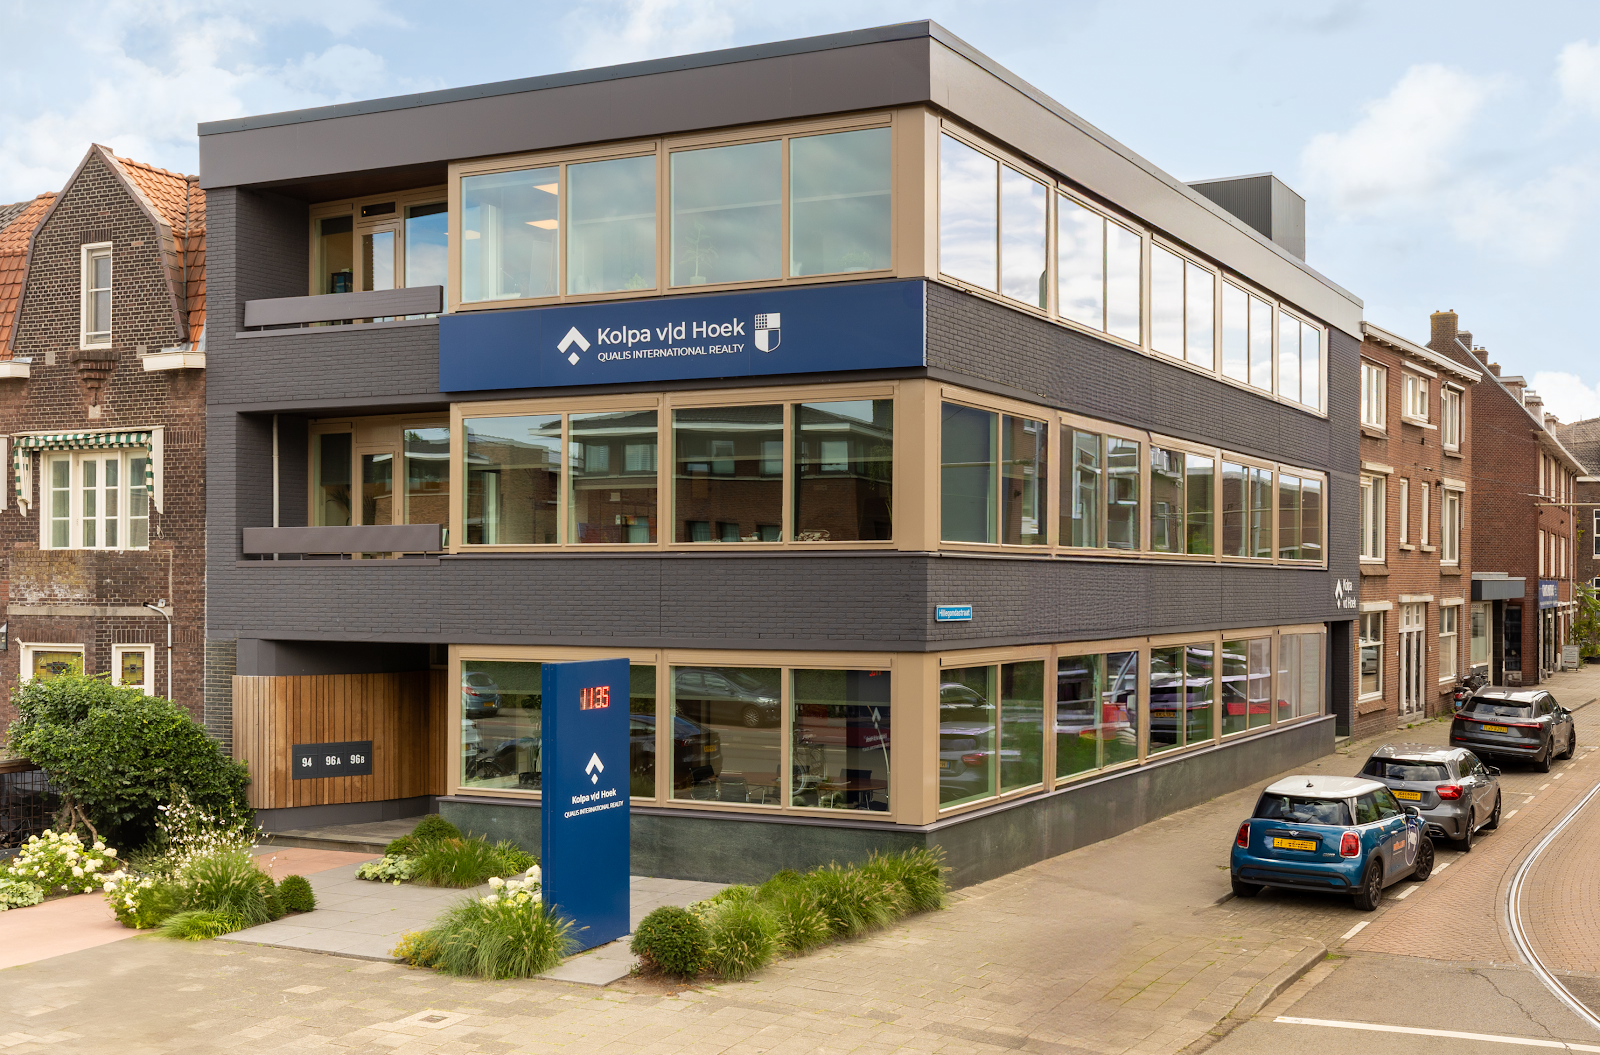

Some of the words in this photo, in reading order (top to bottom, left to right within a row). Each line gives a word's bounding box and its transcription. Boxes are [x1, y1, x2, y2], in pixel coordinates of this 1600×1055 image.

[598, 325, 651, 348] Kolpa
[692, 318, 745, 339] Hoek
[597, 350, 632, 363] QUALIS
[632, 346, 708, 359] INTERNATIONAL
[708, 343, 745, 355] REALTY
[302, 757, 312, 767] 94
[325, 756, 341, 766] 96A
[350, 754, 365, 764] 96B
[572, 795, 590, 804] Kolpa
[601, 788, 617, 798] Hoek
[564, 810, 580, 818] QUALIS
[580, 804, 610, 815] INTERNATIONAL
[610, 800, 624, 809] REALTY
